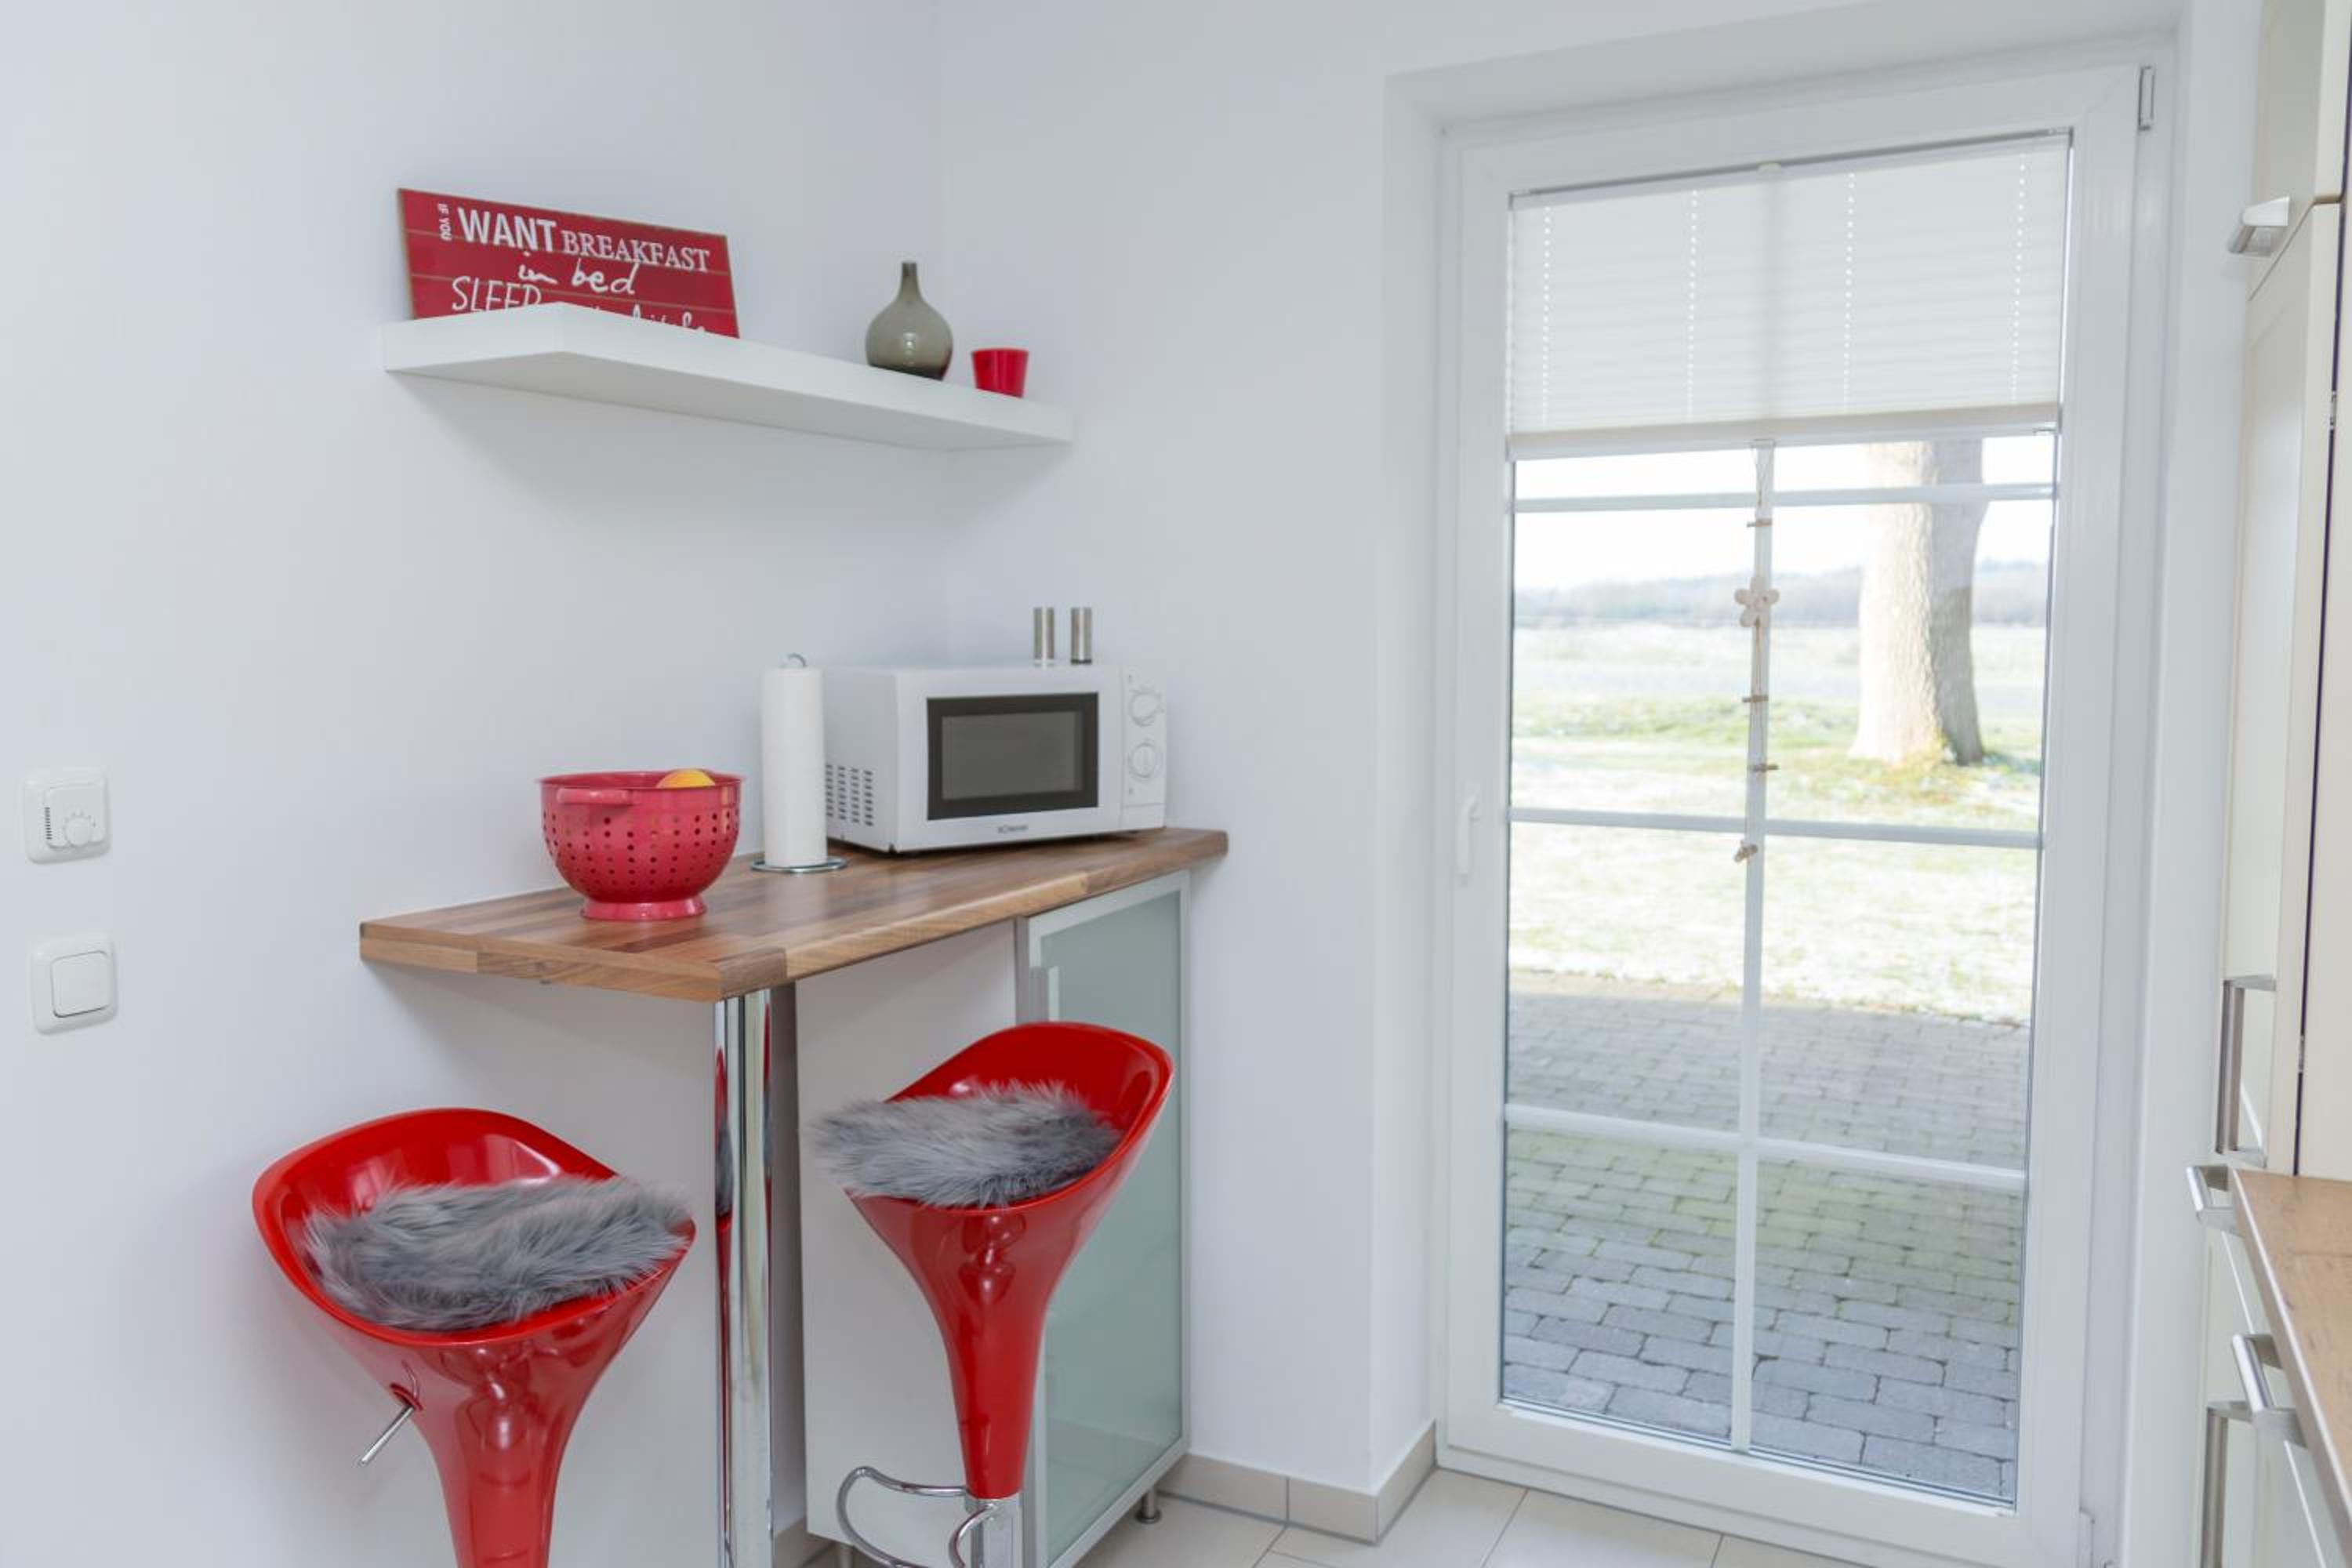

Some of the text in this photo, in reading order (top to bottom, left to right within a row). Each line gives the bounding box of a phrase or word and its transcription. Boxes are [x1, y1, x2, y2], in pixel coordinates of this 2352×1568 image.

[437, 203, 452, 241] IF YOU
[457, 207, 710, 272] WANT BREAKFAST
[517, 251, 640, 295] in bed
